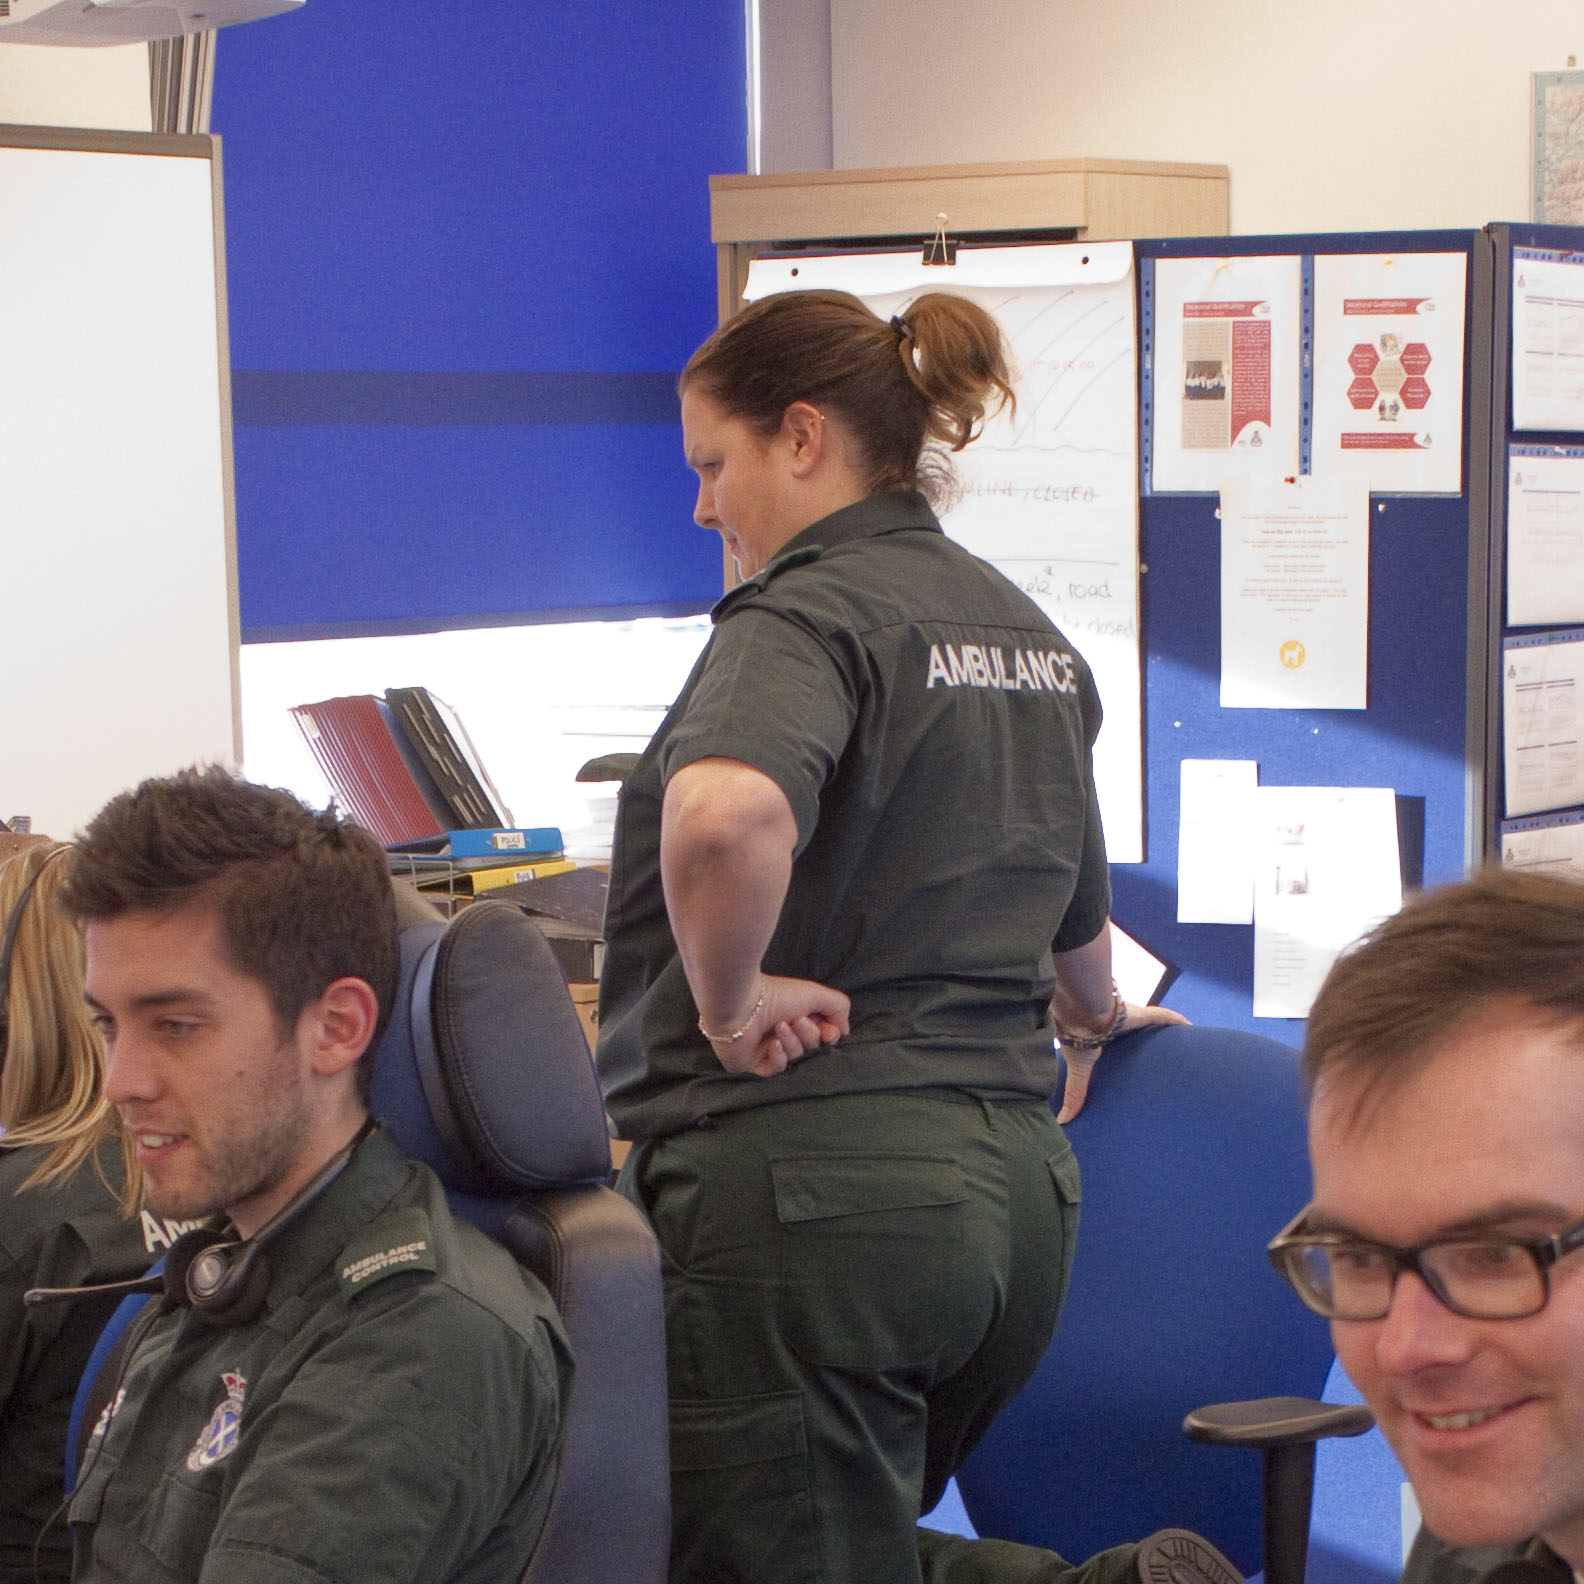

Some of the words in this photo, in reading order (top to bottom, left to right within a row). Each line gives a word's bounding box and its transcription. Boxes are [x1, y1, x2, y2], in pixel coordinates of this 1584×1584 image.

[1069, 579, 1112, 599] road
[927, 644, 1077, 694] AMBULANCE
[343, 1241, 426, 1278] AMBULANCE
[352, 1252, 419, 1283] CONTROL
